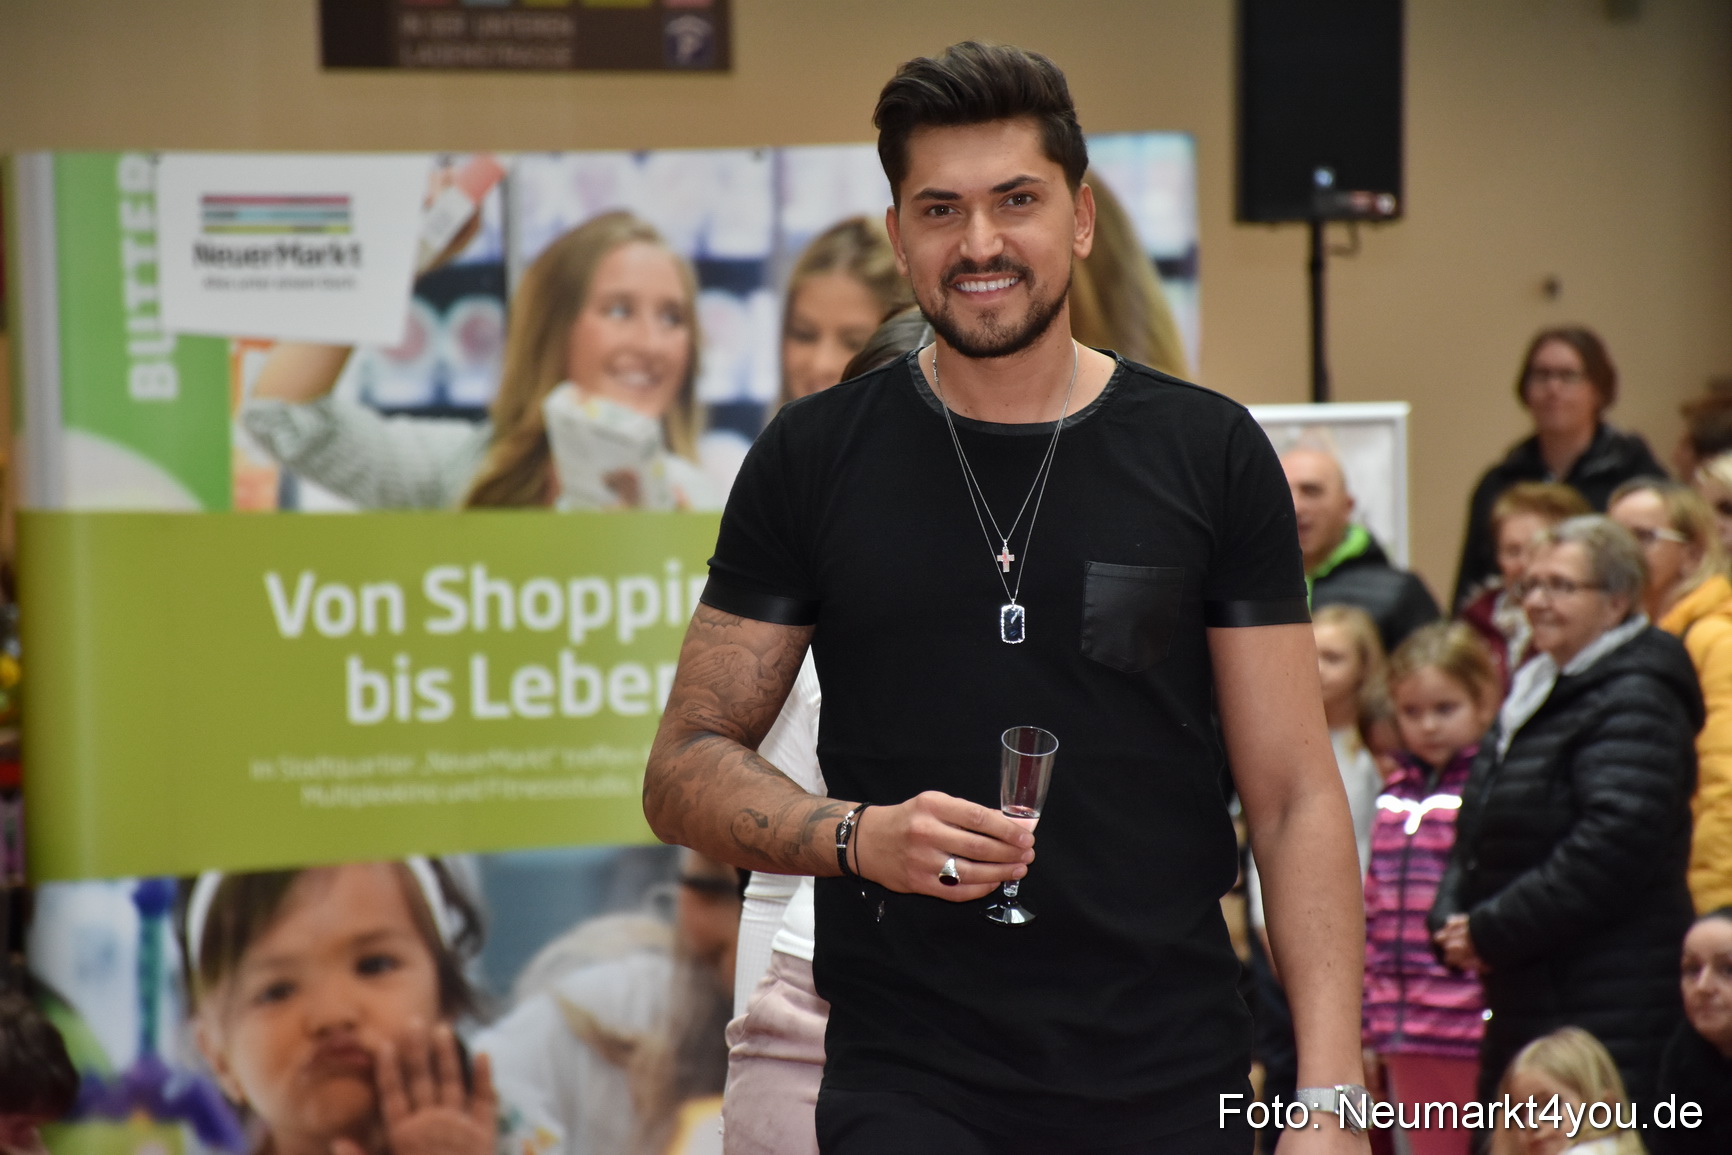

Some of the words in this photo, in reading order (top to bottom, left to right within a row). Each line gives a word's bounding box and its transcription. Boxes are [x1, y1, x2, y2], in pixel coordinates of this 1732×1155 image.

[193, 242, 363, 268] NeuerMarkt
[264, 570, 405, 638] Von
[346, 653, 455, 724] bis
